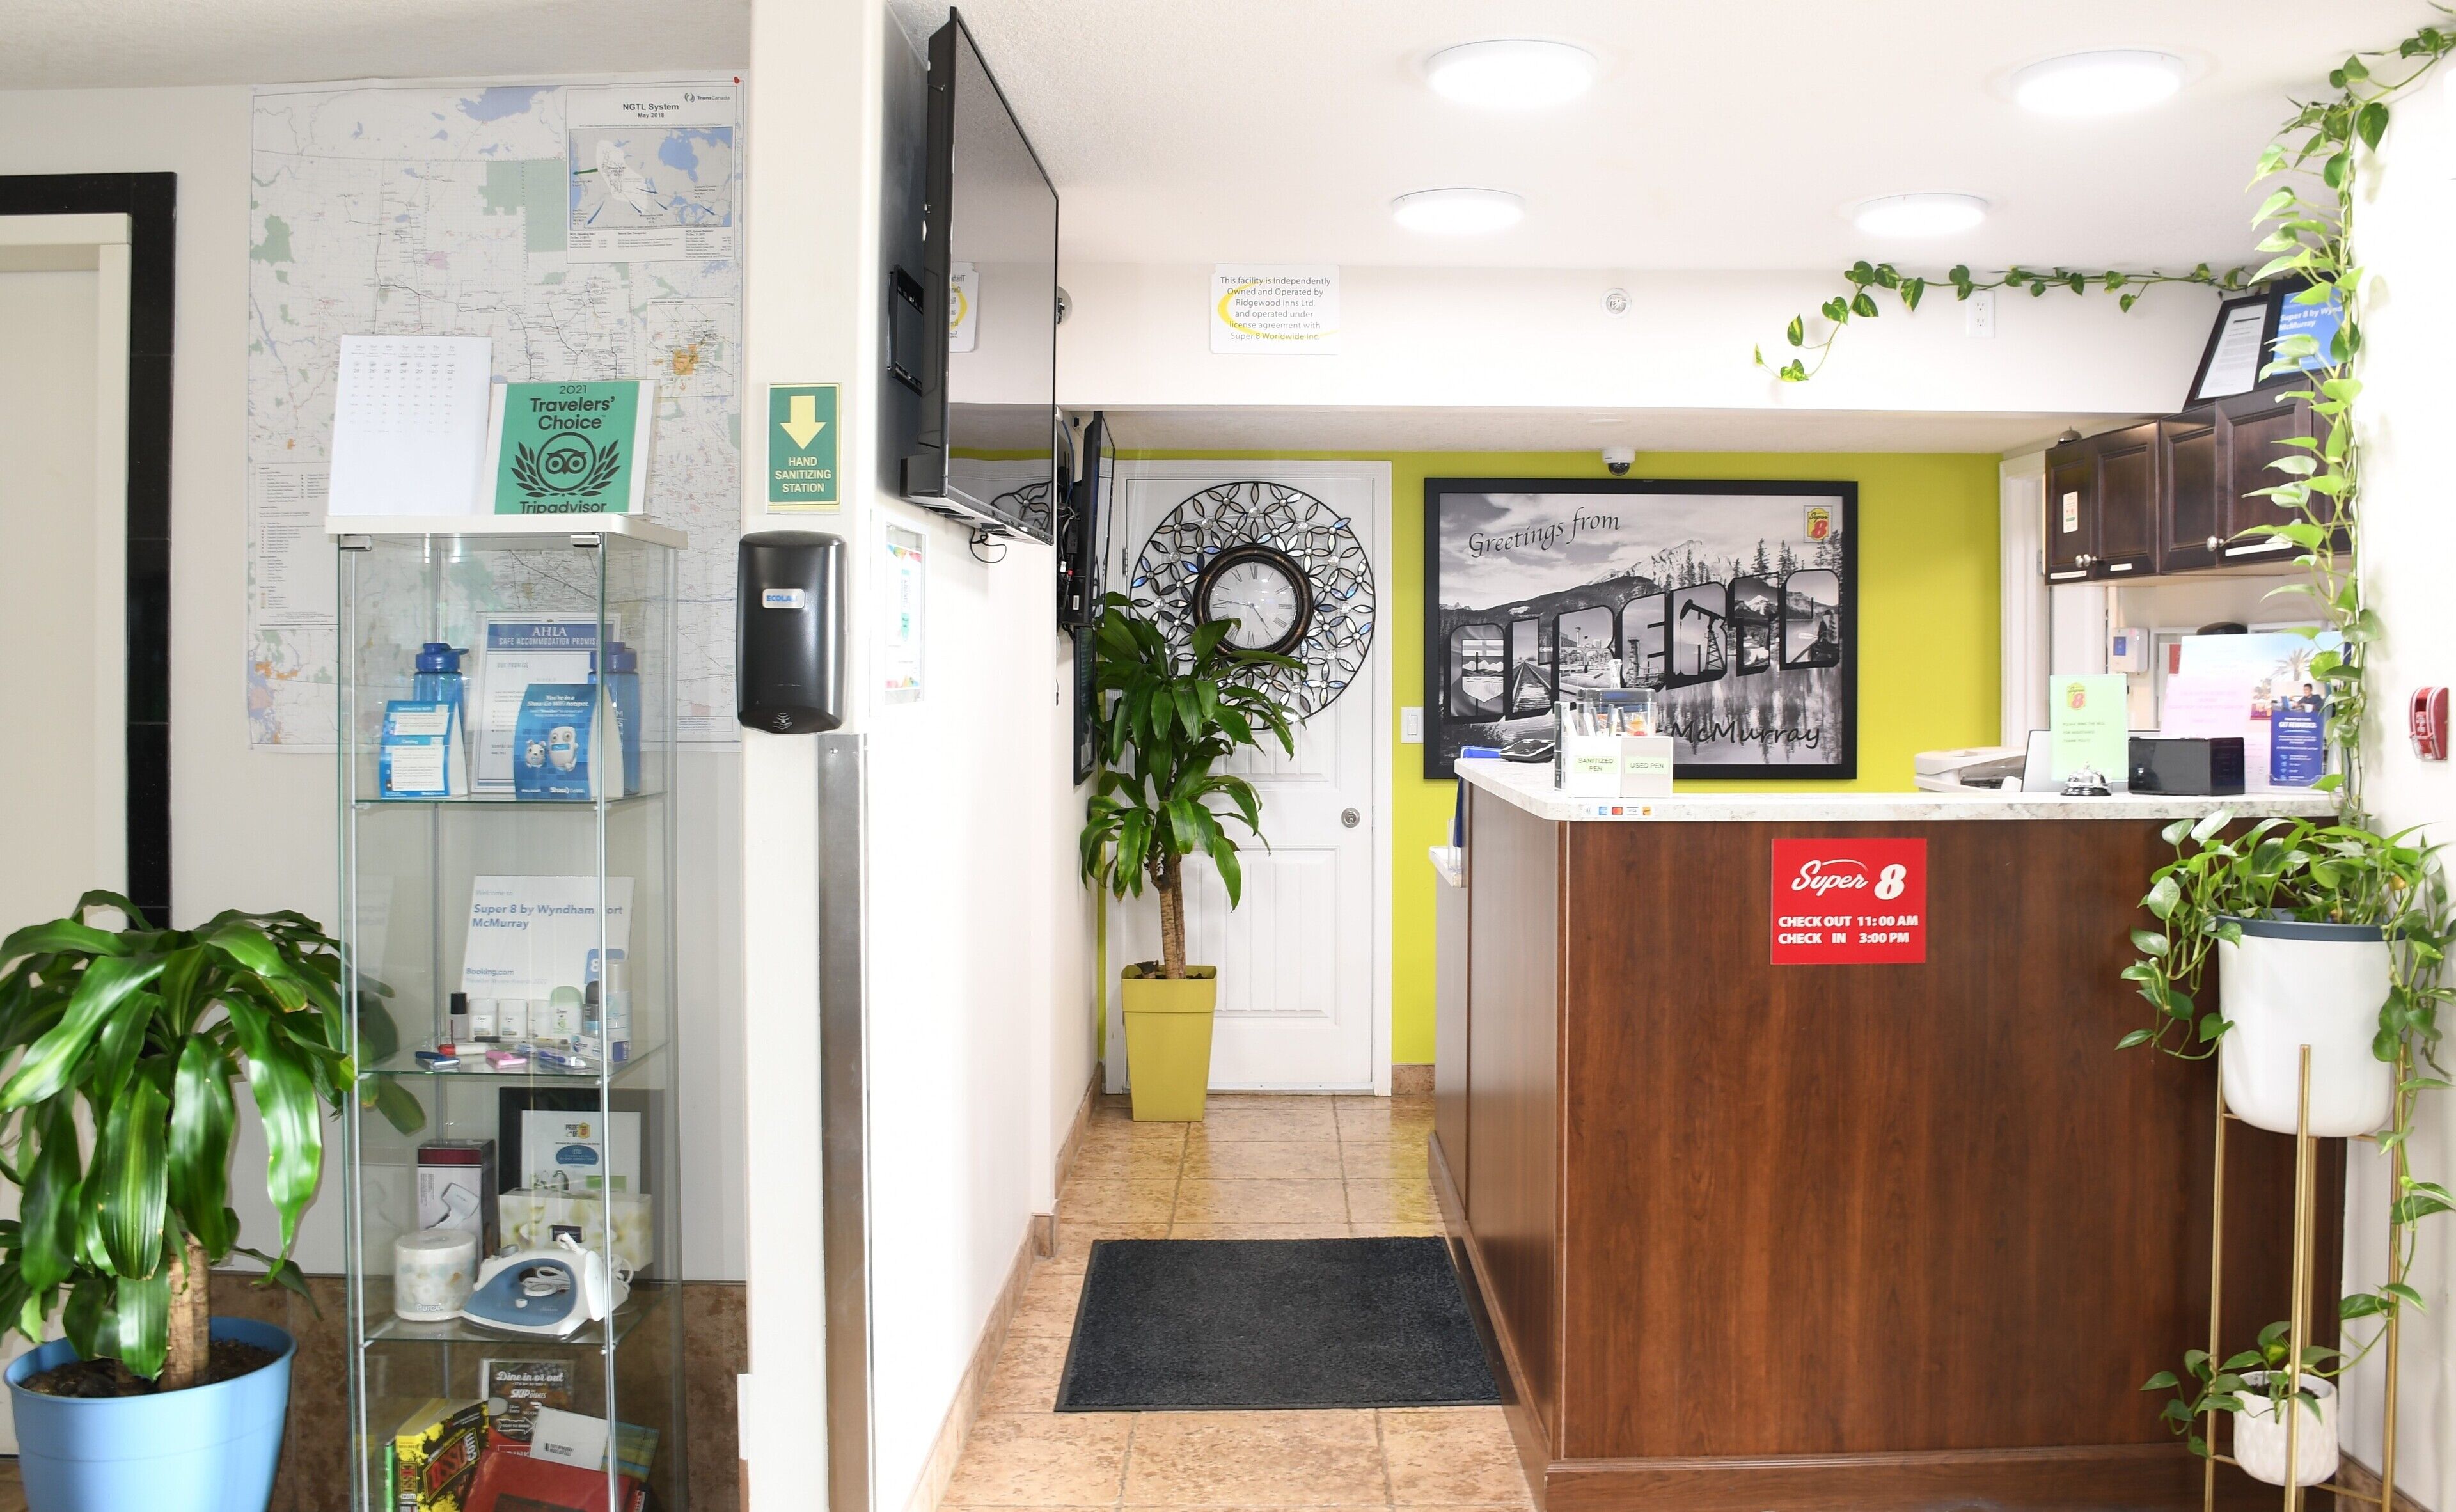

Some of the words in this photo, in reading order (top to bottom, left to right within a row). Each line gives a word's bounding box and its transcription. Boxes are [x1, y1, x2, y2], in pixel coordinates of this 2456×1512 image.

[648, 103, 679, 112] System
[1238, 276, 1264, 286] facility
[1273, 277, 1331, 286] Independently
[1275, 288, 1312, 297] Operated
[1314, 288, 1324, 297] by
[1236, 299, 1280, 308] Ridgewood
[1252, 311, 1287, 320] operated
[1231, 333, 1254, 341] Super
[559, 385, 587, 394] 2021
[788, 457, 817, 466] HAND
[775, 469, 831, 480] SANITIZING
[782, 483, 824, 492] STATION
[520, 500, 608, 514] Tripadvisor
[1468, 521, 1564, 558] Greetings
[1566, 507, 1621, 545] from
[1811, 520, 1828, 539] 8
[532, 626, 567, 636] AHLA
[499, 637, 514, 645] SAFE
[517, 637, 570, 645] ACCOMMODATION
[1444, 569, 1841, 724] ALBERTA
[1671, 720, 1820, 750] McMurray
[1791, 859, 1869, 896] Super
[1874, 863, 1907, 900] 8
[473, 904, 507, 915] Super
[510, 904, 517, 914] 8
[520, 904, 535, 916] by
[537, 904, 595, 917] Wyndham
[602, 906, 623, 915] ort
[472, 918, 529, 930] McMurray
[1777, 916, 1822, 927] CHECK
[1823, 915, 1852, 927] OUT
[1896, 915, 1919, 926] AM
[1777, 933, 1822, 944] CHECK
[1831, 933, 1846, 943] IN
[1859, 932, 1887, 943] 3:00
[1889, 932, 1910, 943] PM
[466, 968, 515, 976] Booking.com
[496, 1371, 522, 1381] Dine
[523, 1373, 532, 1381] in
[547, 1373, 564, 1382] out
[510, 1389, 531, 1398] SKIP
